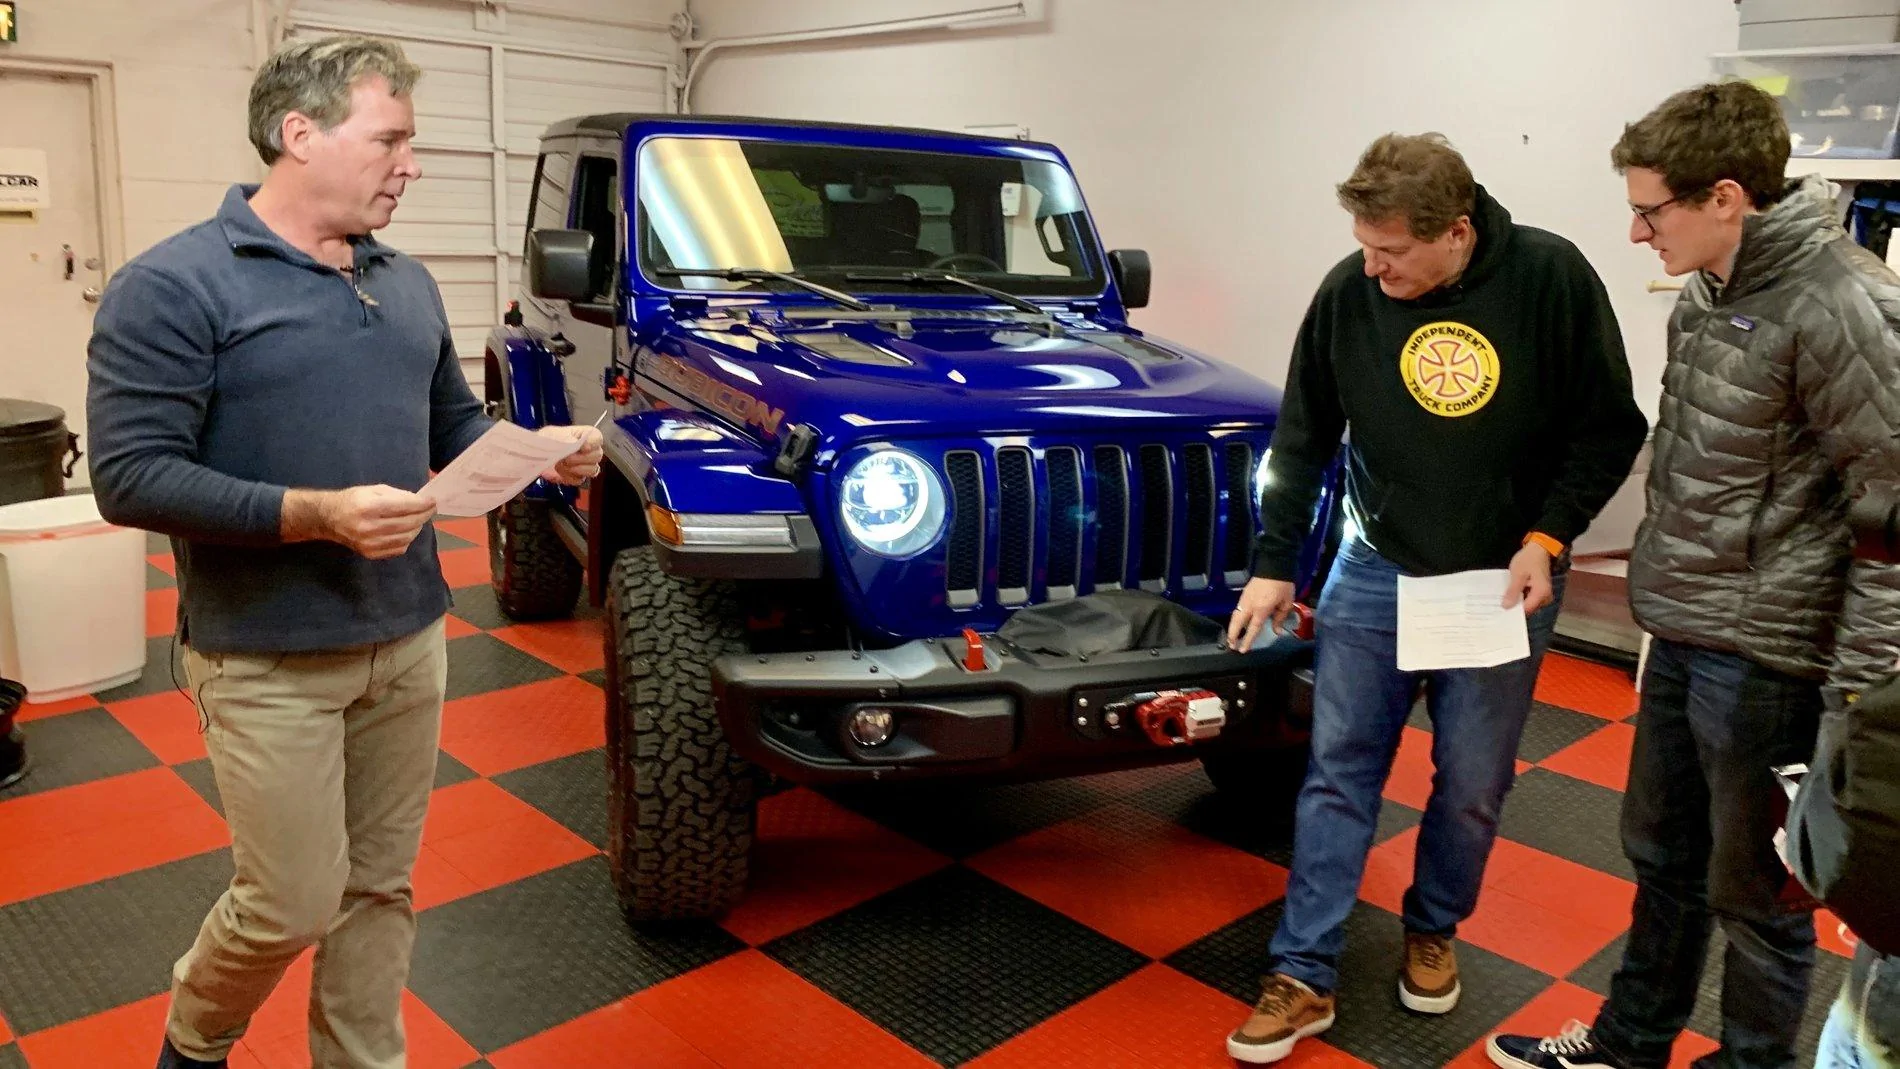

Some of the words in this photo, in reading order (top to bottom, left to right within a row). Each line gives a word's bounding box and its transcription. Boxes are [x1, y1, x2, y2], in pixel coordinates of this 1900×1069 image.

[1407, 326, 1487, 356] INDEPENDENT
[649, 351, 786, 434] RUBICON
[1407, 378, 1442, 411] TRUCK
[1445, 375, 1493, 412] COMPANY
